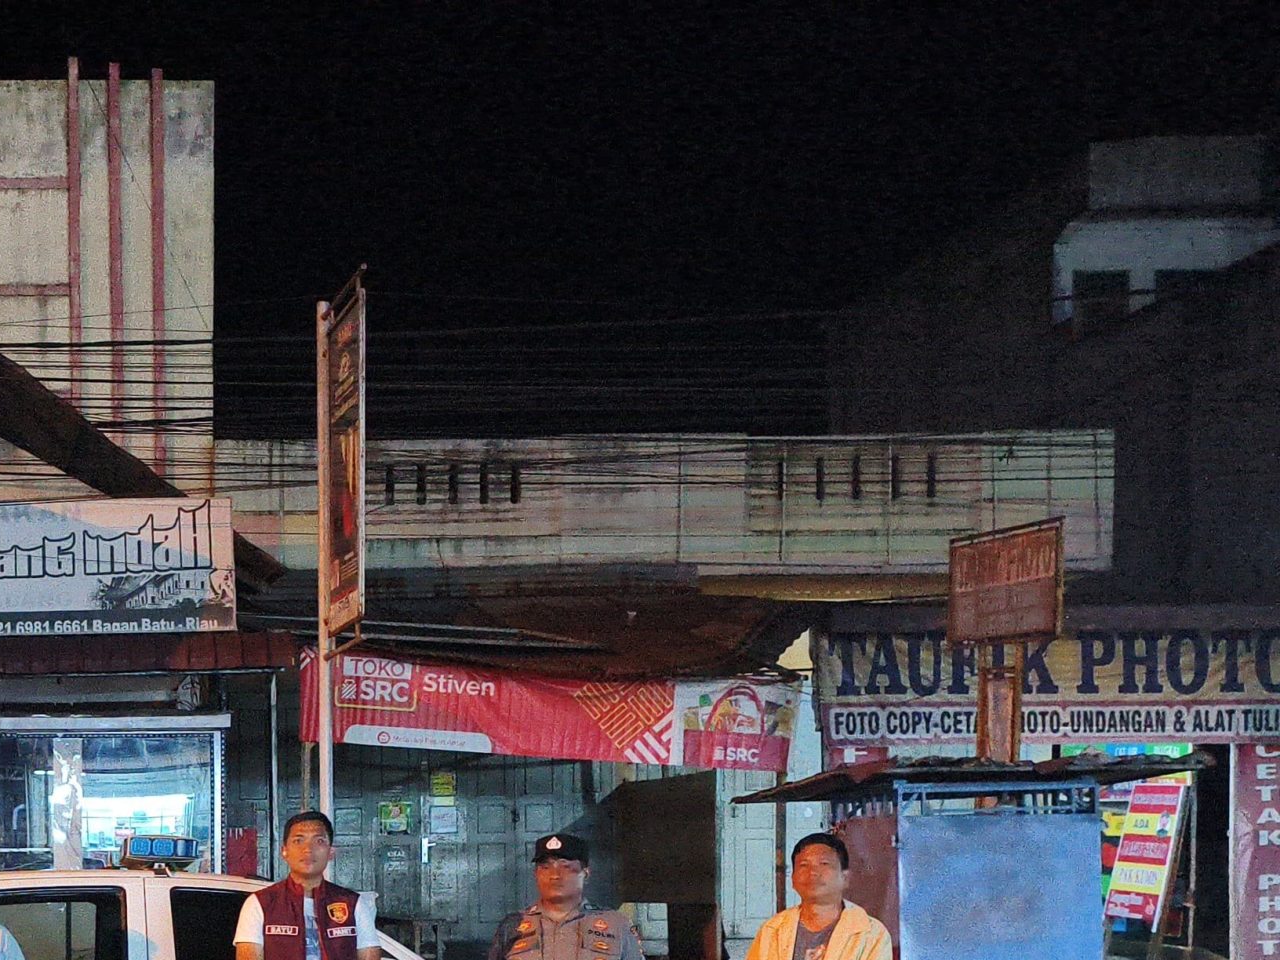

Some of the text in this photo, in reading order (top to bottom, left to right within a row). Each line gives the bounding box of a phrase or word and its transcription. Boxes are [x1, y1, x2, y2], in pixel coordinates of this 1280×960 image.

[16, 620, 50, 634] 6981
[53, 619, 88, 633] 6661
[141, 617, 174, 631] Batu
[185, 616, 219, 630] Riau
[350, 658, 406, 676] TOKO
[360, 680, 410, 703] SRC
[422, 672, 496, 697] Stiven
[834, 710, 881, 735] FOTO
[1172, 708, 1187, 734] &
[1192, 709, 1236, 733] ALAT
[725, 747, 761, 763] SRC
